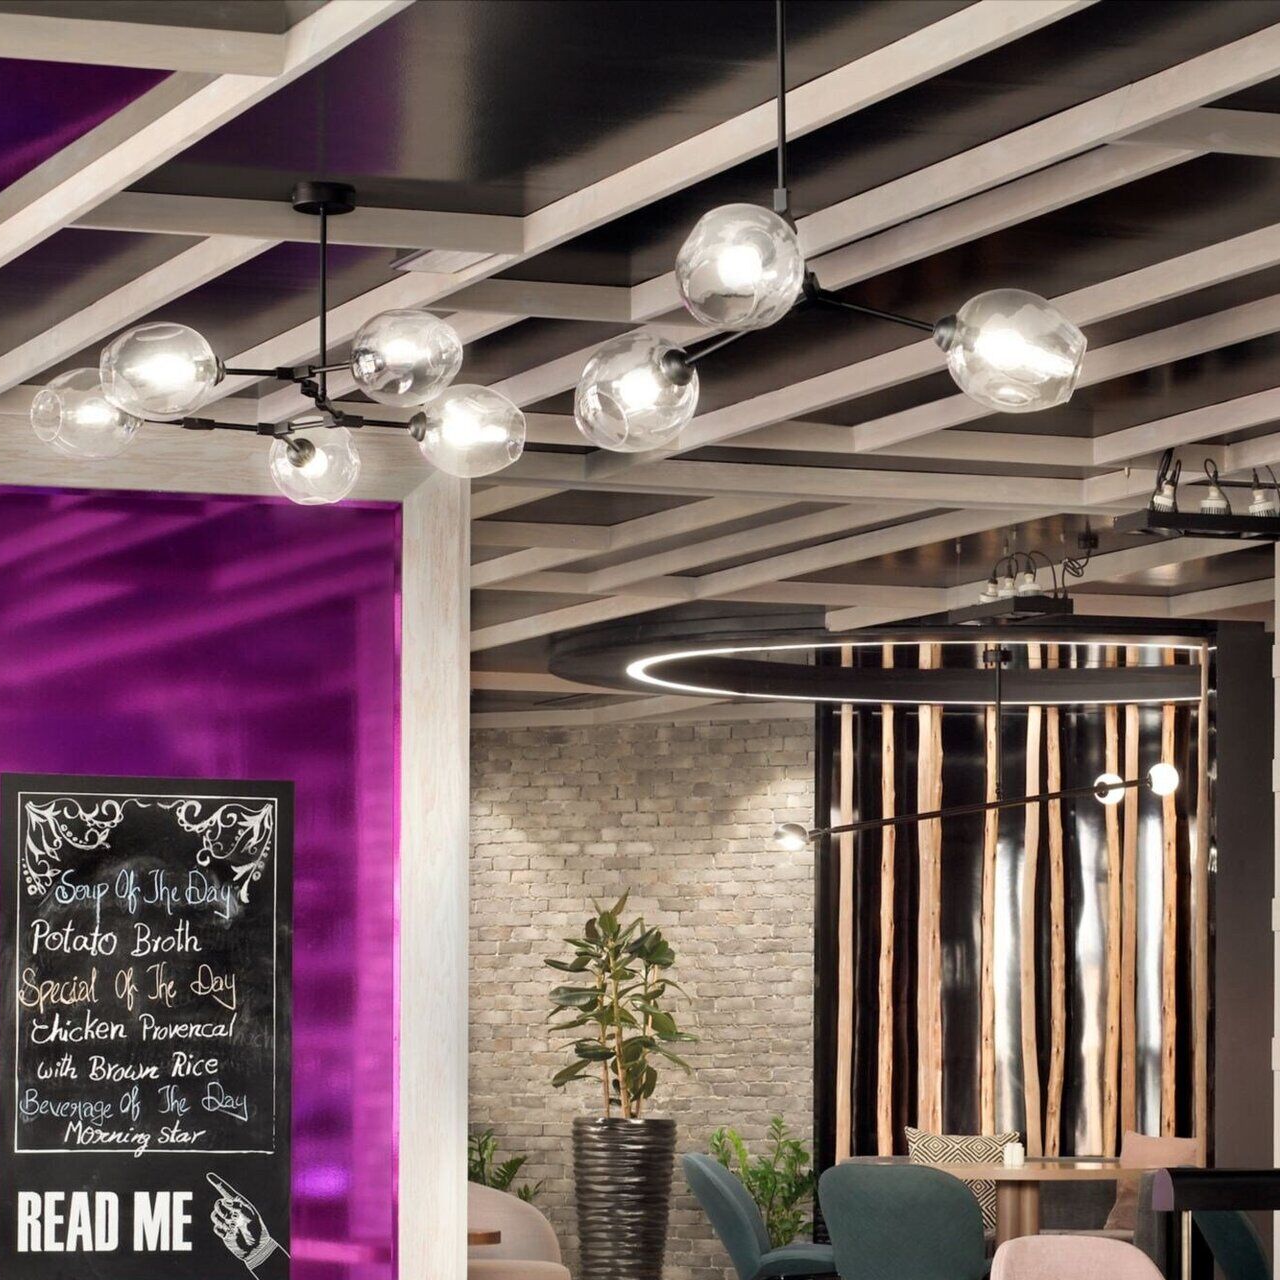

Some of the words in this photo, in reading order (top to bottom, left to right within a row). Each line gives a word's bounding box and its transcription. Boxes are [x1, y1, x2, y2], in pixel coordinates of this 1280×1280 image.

[54, 868, 109, 926] Soup
[114, 868, 141, 914] Of
[143, 869, 179, 915] The
[185, 869, 232, 919] Day
[30, 918, 117, 956] Potato
[130, 918, 202, 957] Broth
[19, 966, 99, 1014] Special
[114, 966, 138, 1011] Of
[146, 961, 177, 1008] The
[189, 963, 236, 1011] Day
[138, 1012, 238, 1042] Provencal
[37, 1052, 78, 1080] with
[88, 1055, 160, 1082] Brown
[171, 1050, 219, 1078] Rice
[18, 1088, 114, 1127] Beverage
[119, 1085, 142, 1122] Of
[157, 1084, 191, 1117] The
[201, 1081, 249, 1122] Day
[63, 1120, 151, 1159] Morning
[17, 1190, 120, 1252] READ
[132, 1190, 194, 1252] ME
